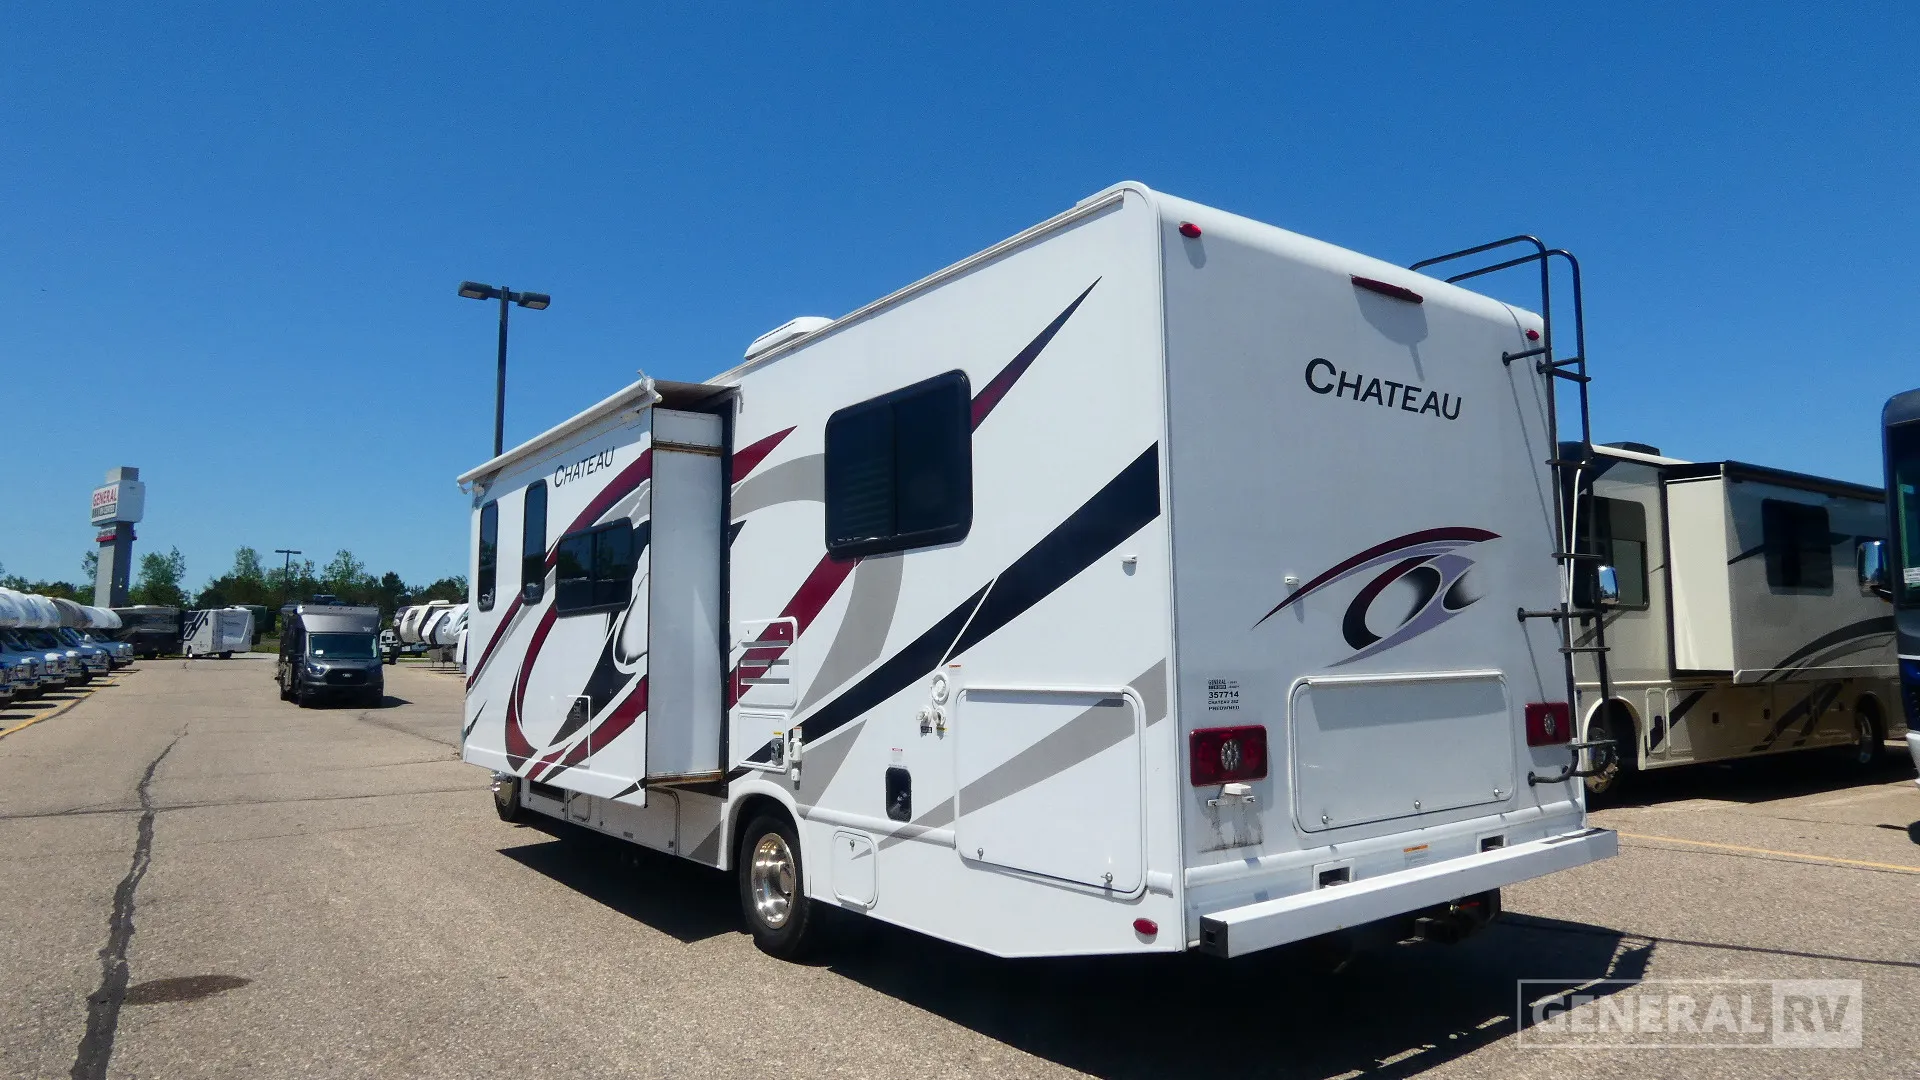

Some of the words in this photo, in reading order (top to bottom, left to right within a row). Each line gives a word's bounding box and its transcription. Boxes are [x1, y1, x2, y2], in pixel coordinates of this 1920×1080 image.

[1305, 358, 1462, 420] CHATEAU
[554, 446, 615, 488] CHATEAU
[93, 487, 117, 507] GENERAL
[1208, 690, 1239, 699] 357714
